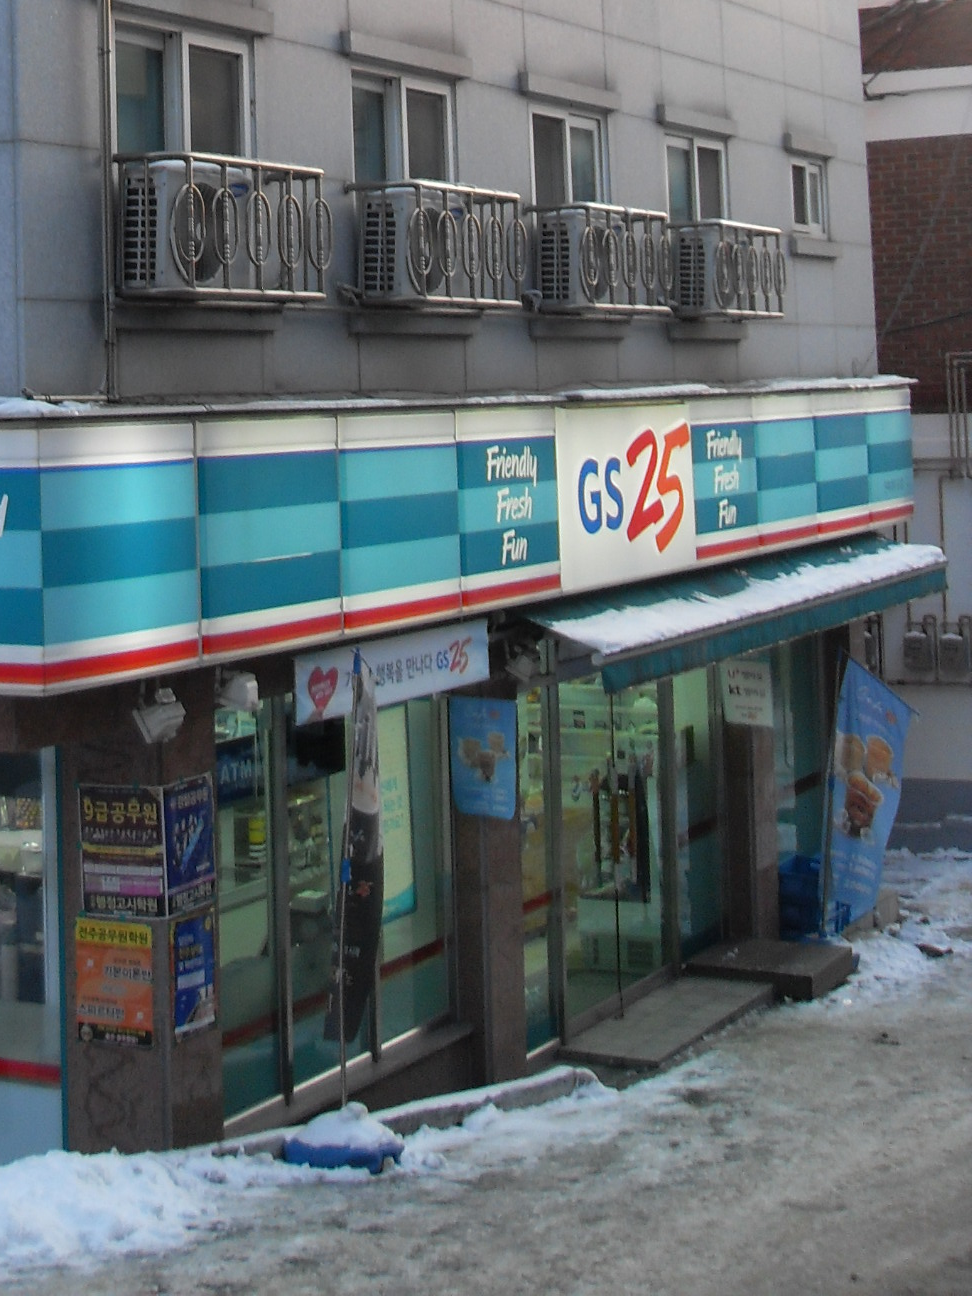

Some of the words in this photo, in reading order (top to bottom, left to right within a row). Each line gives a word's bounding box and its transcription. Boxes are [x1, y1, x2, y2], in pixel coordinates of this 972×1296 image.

[706, 429, 742, 464] Friendly
[486, 445, 537, 487] Friendly
[714, 465, 739, 494] Fresh
[496, 487, 532, 523] Fresh
[578, 422, 690, 554] GS25
[718, 499, 737, 529] Fun
[501, 528, 528, 566] Fun
[406, 655, 433, 680] 만나다
[436, 636, 472, 675] GS25
[220, 759, 252, 784] ATM
[83, 796, 158, 825] 9급공무원
